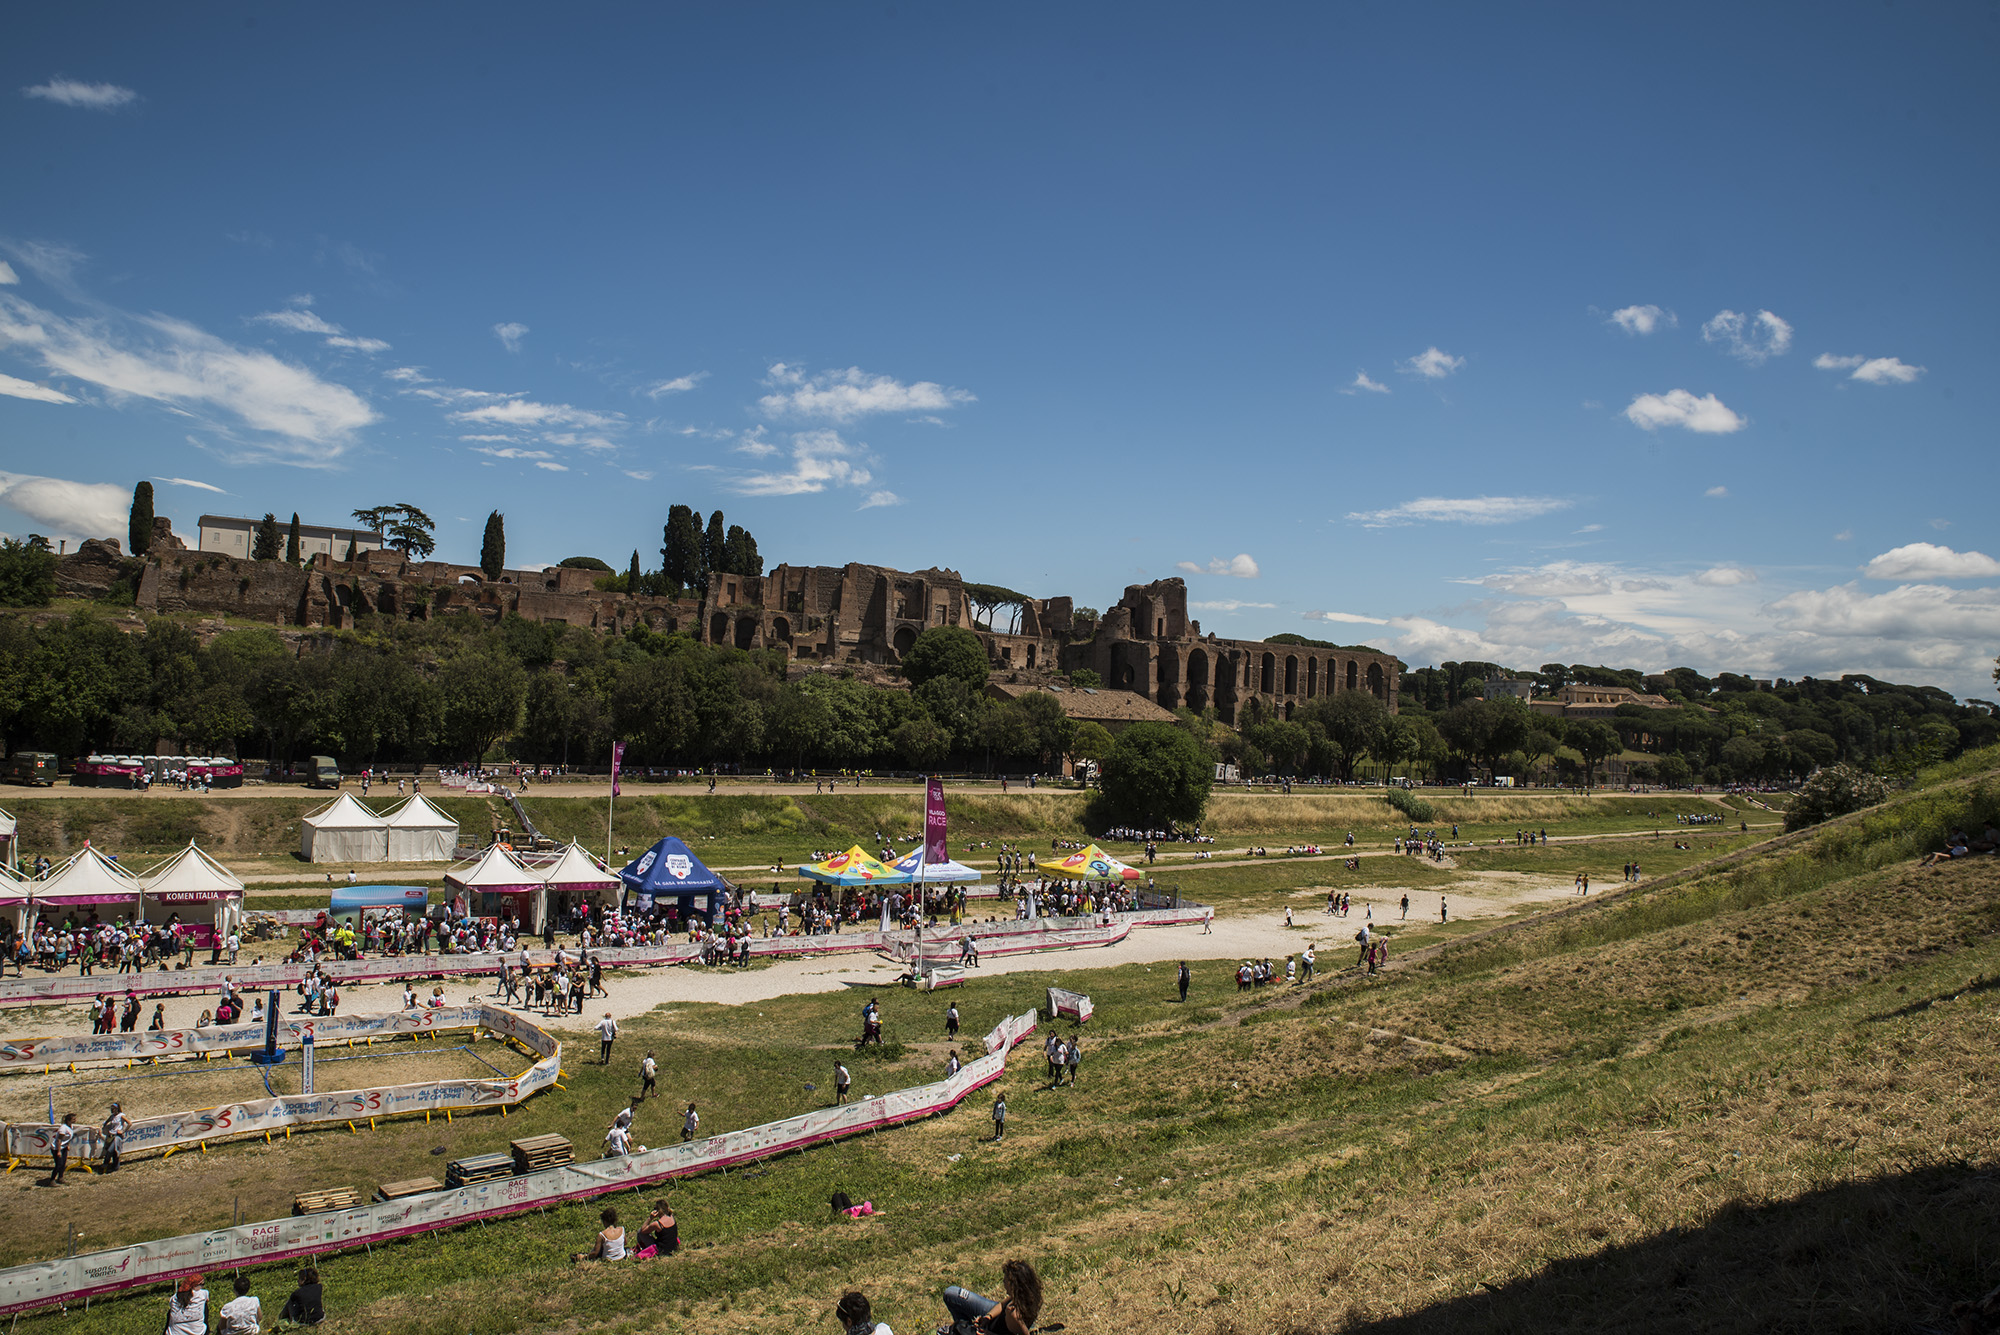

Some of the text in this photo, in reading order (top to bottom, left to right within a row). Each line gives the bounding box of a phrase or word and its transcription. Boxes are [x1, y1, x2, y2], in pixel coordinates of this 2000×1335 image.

[928, 816, 946, 826] RACE
[166, 892, 219, 900] KOMEN ITALIA
[233, 1028, 264, 1036] TOGETHER
[285, 1101, 322, 1110] TOGETHER
[871, 1110, 886, 1118] CURE
[124, 1124, 165, 1137] TOGETHER
[139, 1131, 166, 1141] SPIKE!
[709, 1137, 726, 1145] RACE
[709, 1149, 726, 1157] CURE
[508, 1179, 528, 1188] RACE
[497, 1187, 512, 1196] FOR
[508, 1191, 528, 1200] CURE
[253, 1226, 280, 1236] RACE
[236, 1233, 280, 1246] FOR THE
[252, 1240, 279, 1250] CURE
[292, 1246, 324, 1255] PREVENZIONE
[335, 1240, 355, 1248] SALVARTI
[202, 1249, 227, 1258] OYSHO
[168, 1270, 184, 1278] CIRCO
[185, 1266, 209, 1274] MASSIMO
[230, 1258, 251, 1266] MAGGIO
[25, 1298, 53, 1308] SALVARTI
